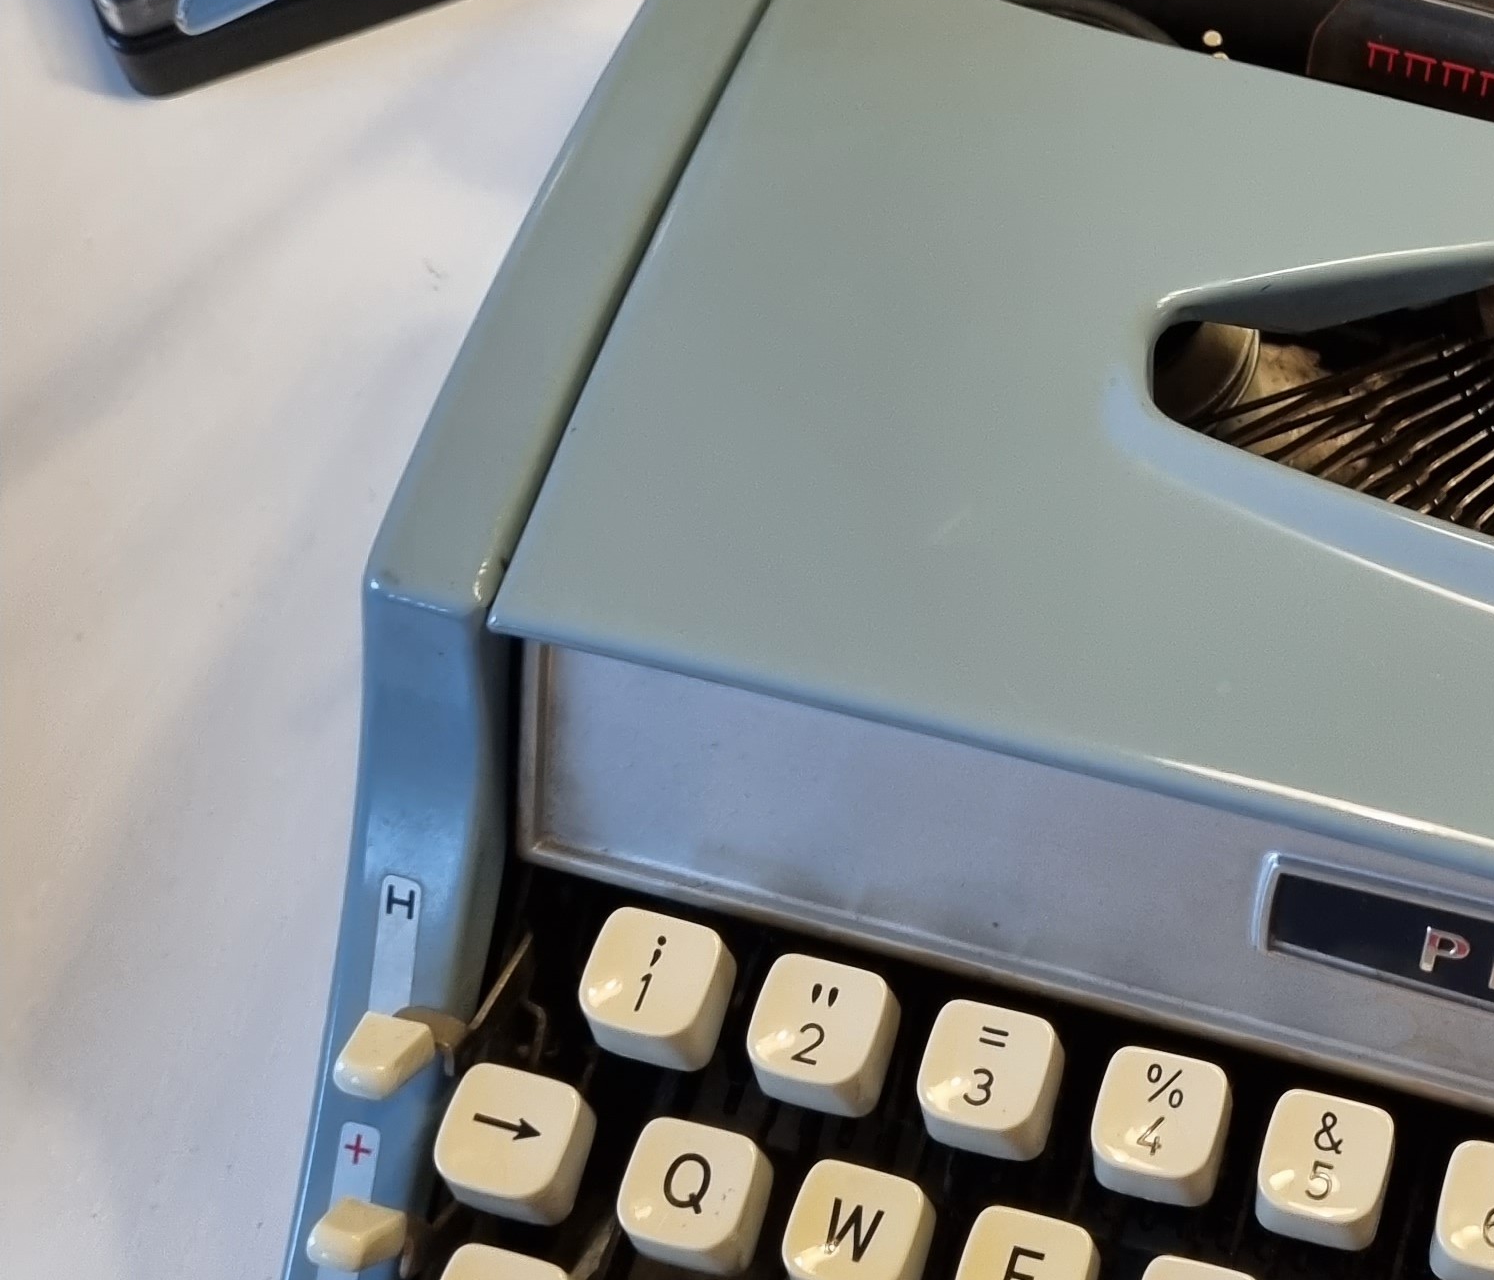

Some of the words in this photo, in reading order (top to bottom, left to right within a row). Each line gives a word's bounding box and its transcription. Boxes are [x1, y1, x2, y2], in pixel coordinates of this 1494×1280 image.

[386, 884, 415, 920] H
[634, 974, 652, 1011] 1
[791, 1023, 824, 1065] 2
[979, 1026, 1009, 1047] =
[963, 1069, 993, 1106] 3
[1148, 1064, 1183, 1108] %
[1136, 1117, 1165, 1156] 4
[1314, 1112, 1342, 1154] &
[664, 1153, 711, 1214] Q
[1305, 1161, 1334, 1200] 5
[826, 1197, 885, 1262] W
